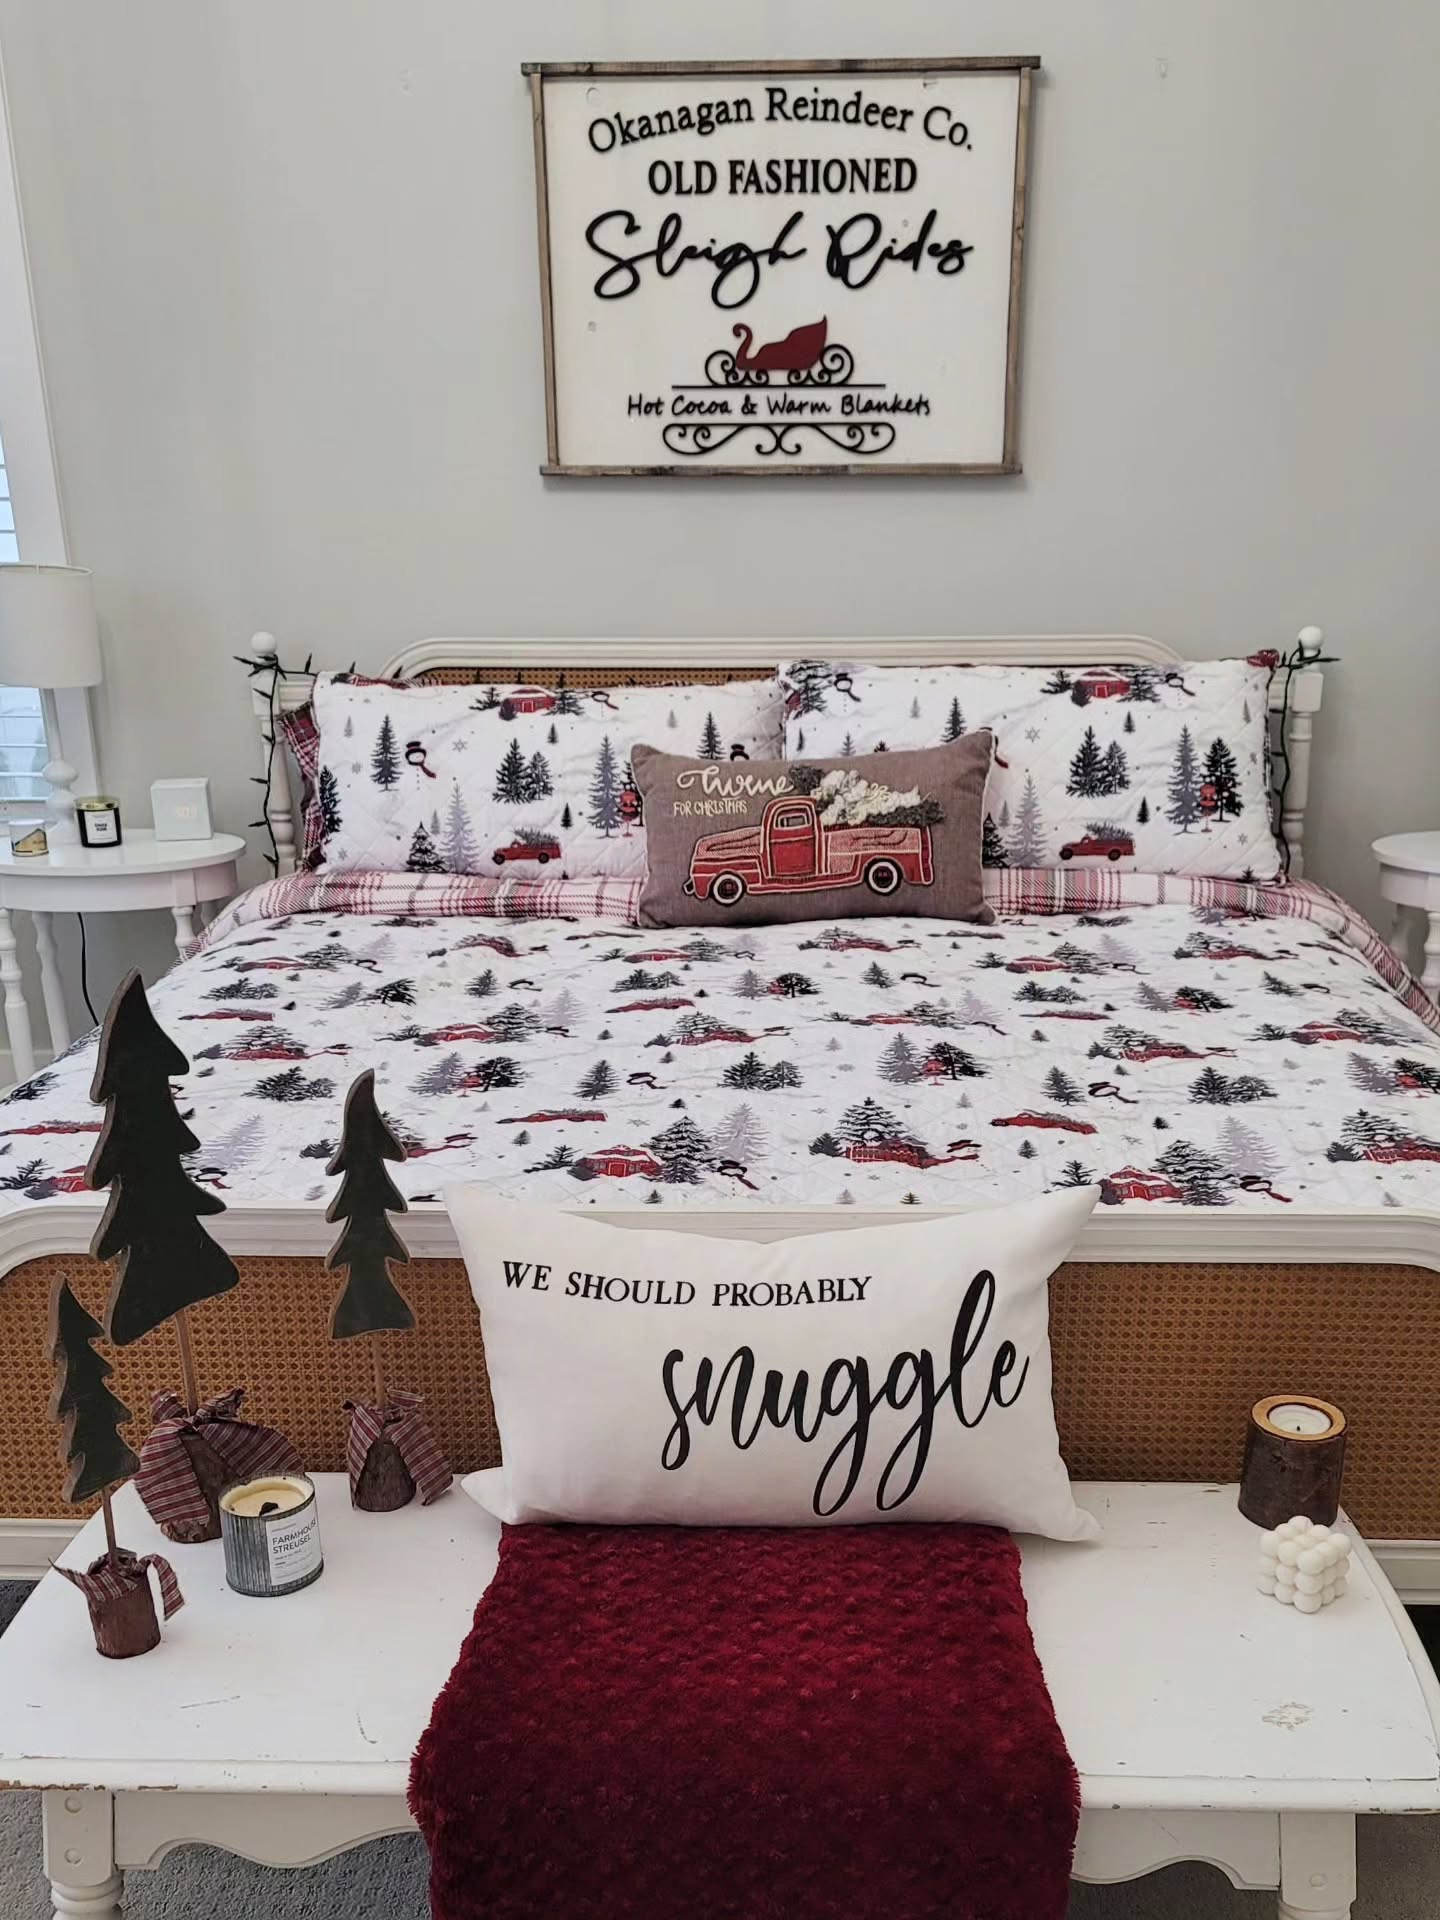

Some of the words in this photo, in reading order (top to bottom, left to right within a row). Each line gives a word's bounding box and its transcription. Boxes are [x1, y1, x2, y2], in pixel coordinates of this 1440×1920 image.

[589, 98, 755, 153] Okanagan
[765, 86, 914, 133] Reindeer
[923, 105, 973, 151] Co.
[648, 159, 718, 196] OLD
[728, 157, 918, 195] FASHIONED
[585, 209, 808, 310] Sleigh
[825, 208, 974, 290] Rides
[627, 393, 665, 417] Hot
[671, 394, 733, 417] Cocoa
[740, 393, 758, 416] &
[766, 392, 832, 417] Warm
[840, 393, 931, 418] Blankets
[673, 801, 693, 819] FOR
[694, 797, 748, 817] CHRISTMAS
[502, 1260, 552, 1291] WE
[565, 1271, 696, 1305] SHOULD
[711, 1276, 872, 1307] PROBABLY
[660, 1269, 1030, 1517] snuggle
[272, 1533, 312, 1555] STREUSEL
